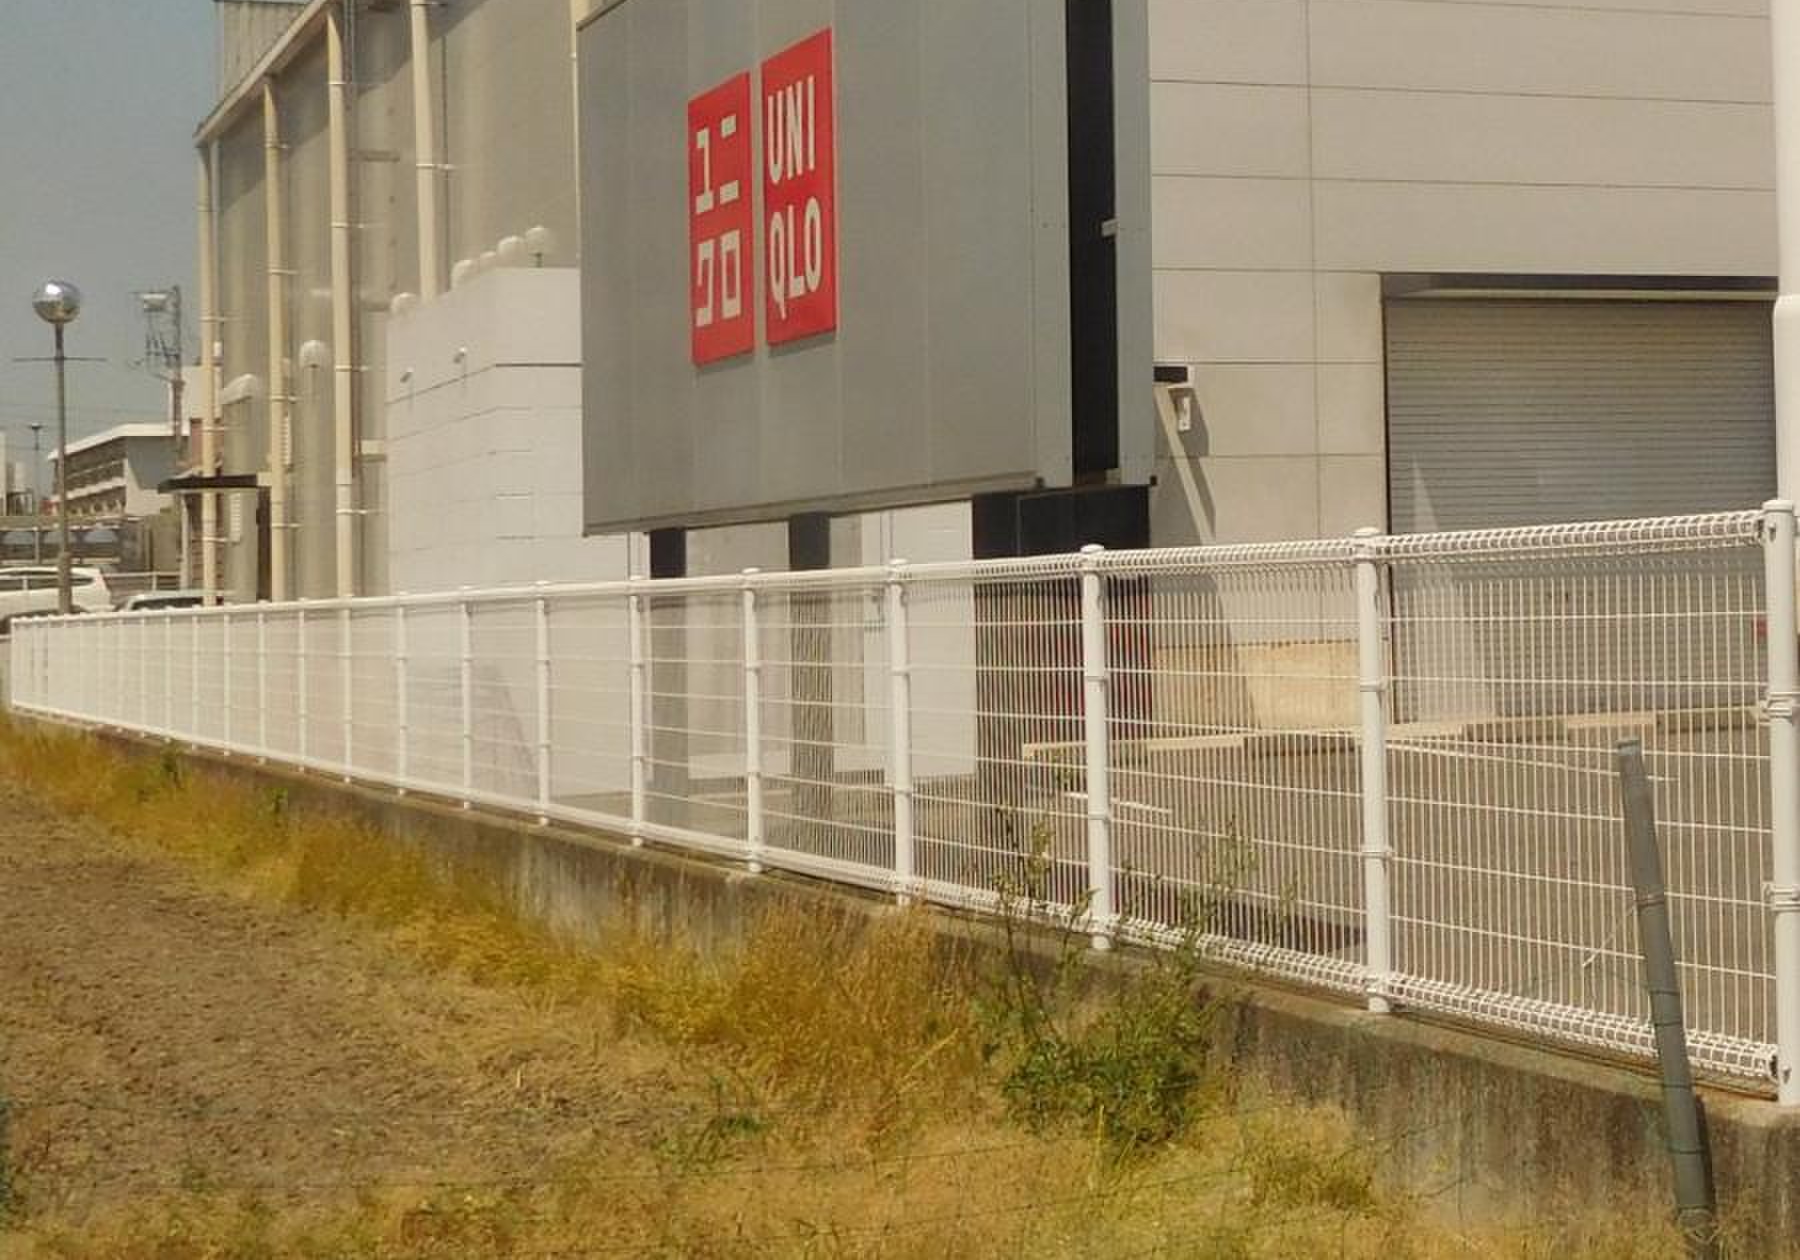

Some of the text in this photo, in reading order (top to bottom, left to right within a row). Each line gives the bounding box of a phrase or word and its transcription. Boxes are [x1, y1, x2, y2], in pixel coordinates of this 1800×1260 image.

[696, 115, 738, 214] ユニ
[768, 75, 815, 183] UNI
[696, 230, 740, 326] クロ
[770, 197, 821, 319] QLO
